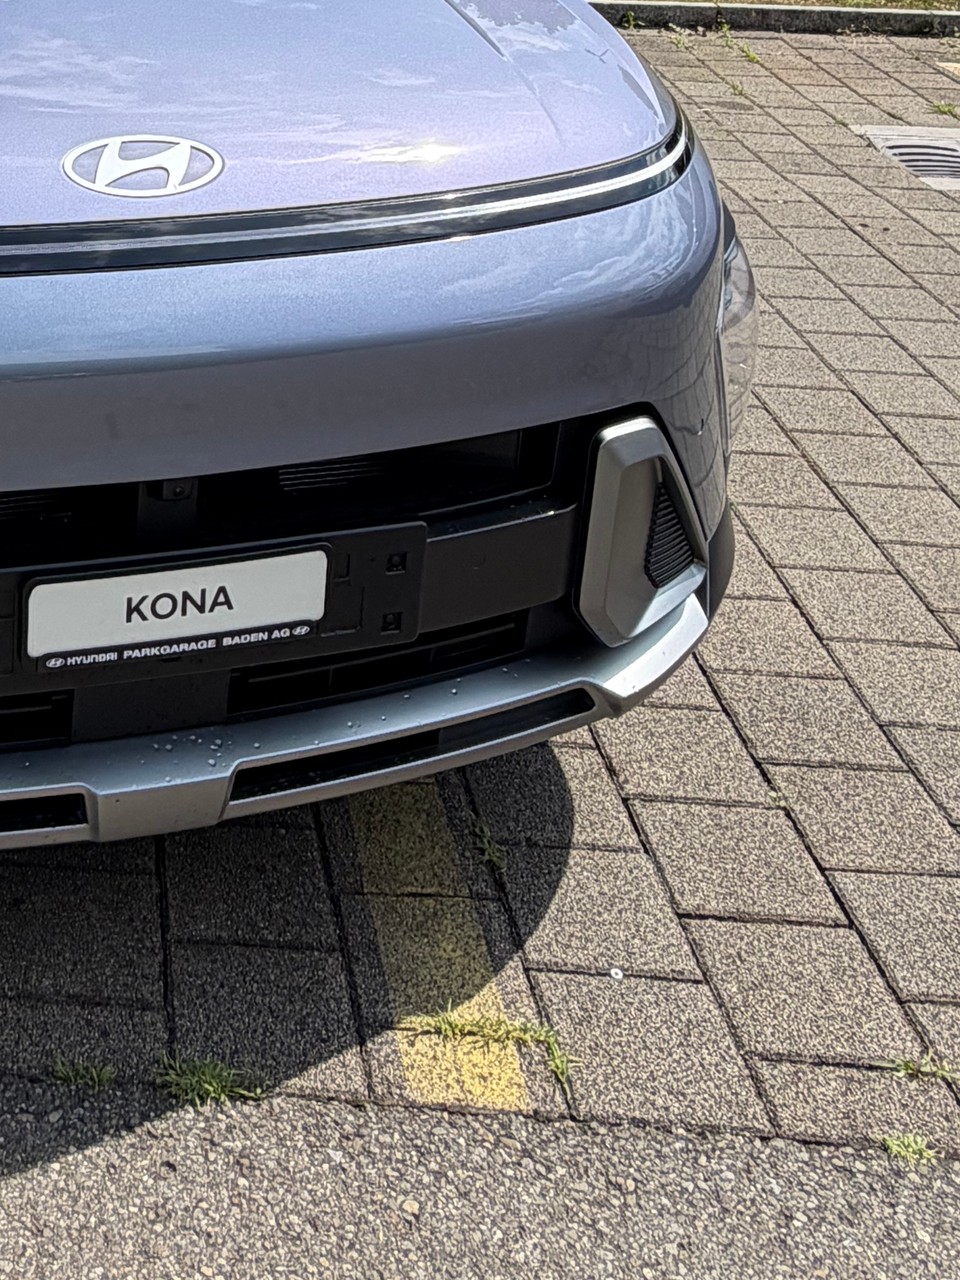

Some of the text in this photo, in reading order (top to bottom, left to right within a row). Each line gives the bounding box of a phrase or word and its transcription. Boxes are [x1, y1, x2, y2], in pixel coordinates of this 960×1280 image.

[125, 585, 234, 623] KONA
[67, 627, 290, 666] HYUNDAI PARKGARAGE BADEN AG
